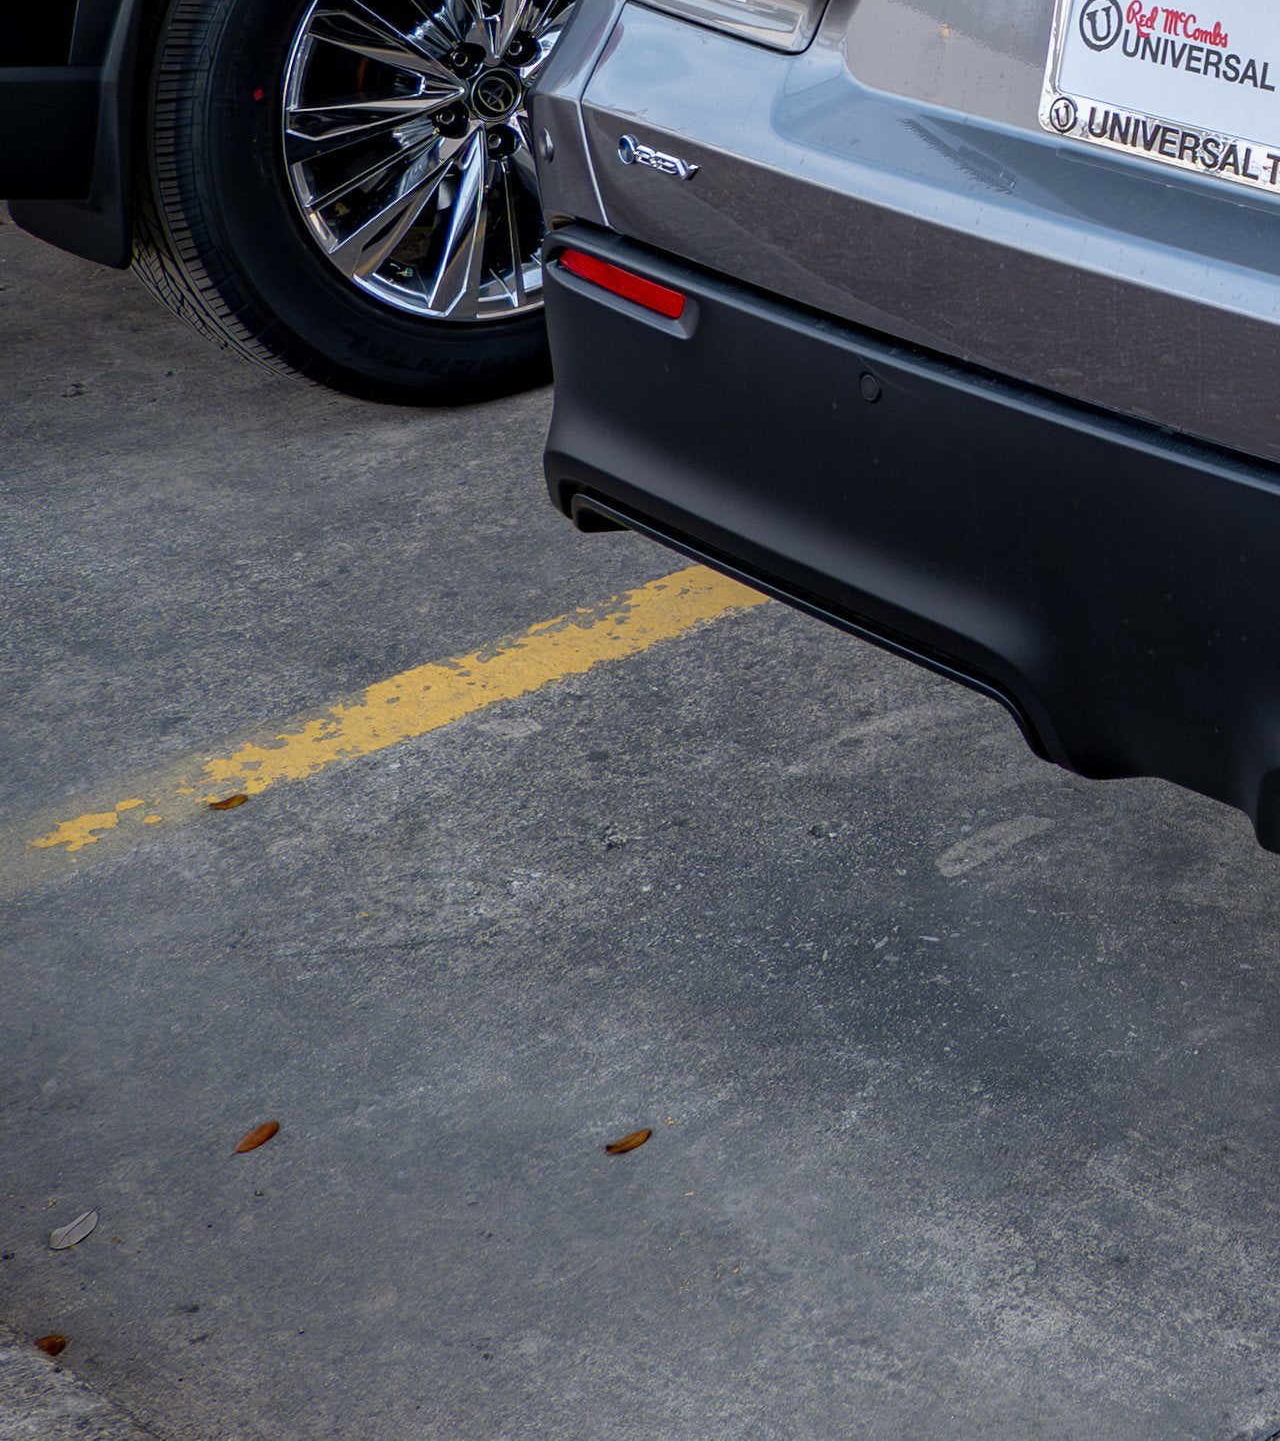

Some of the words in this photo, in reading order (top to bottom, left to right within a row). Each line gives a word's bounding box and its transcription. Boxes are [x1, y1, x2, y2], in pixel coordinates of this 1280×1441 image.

[1126, 0, 1158, 38] Red
[1161, 7, 1228, 48] McCombs
[1122, 29, 1276, 92] UNIVERSAL
[1088, 106, 1260, 181] UNIVERSAL
